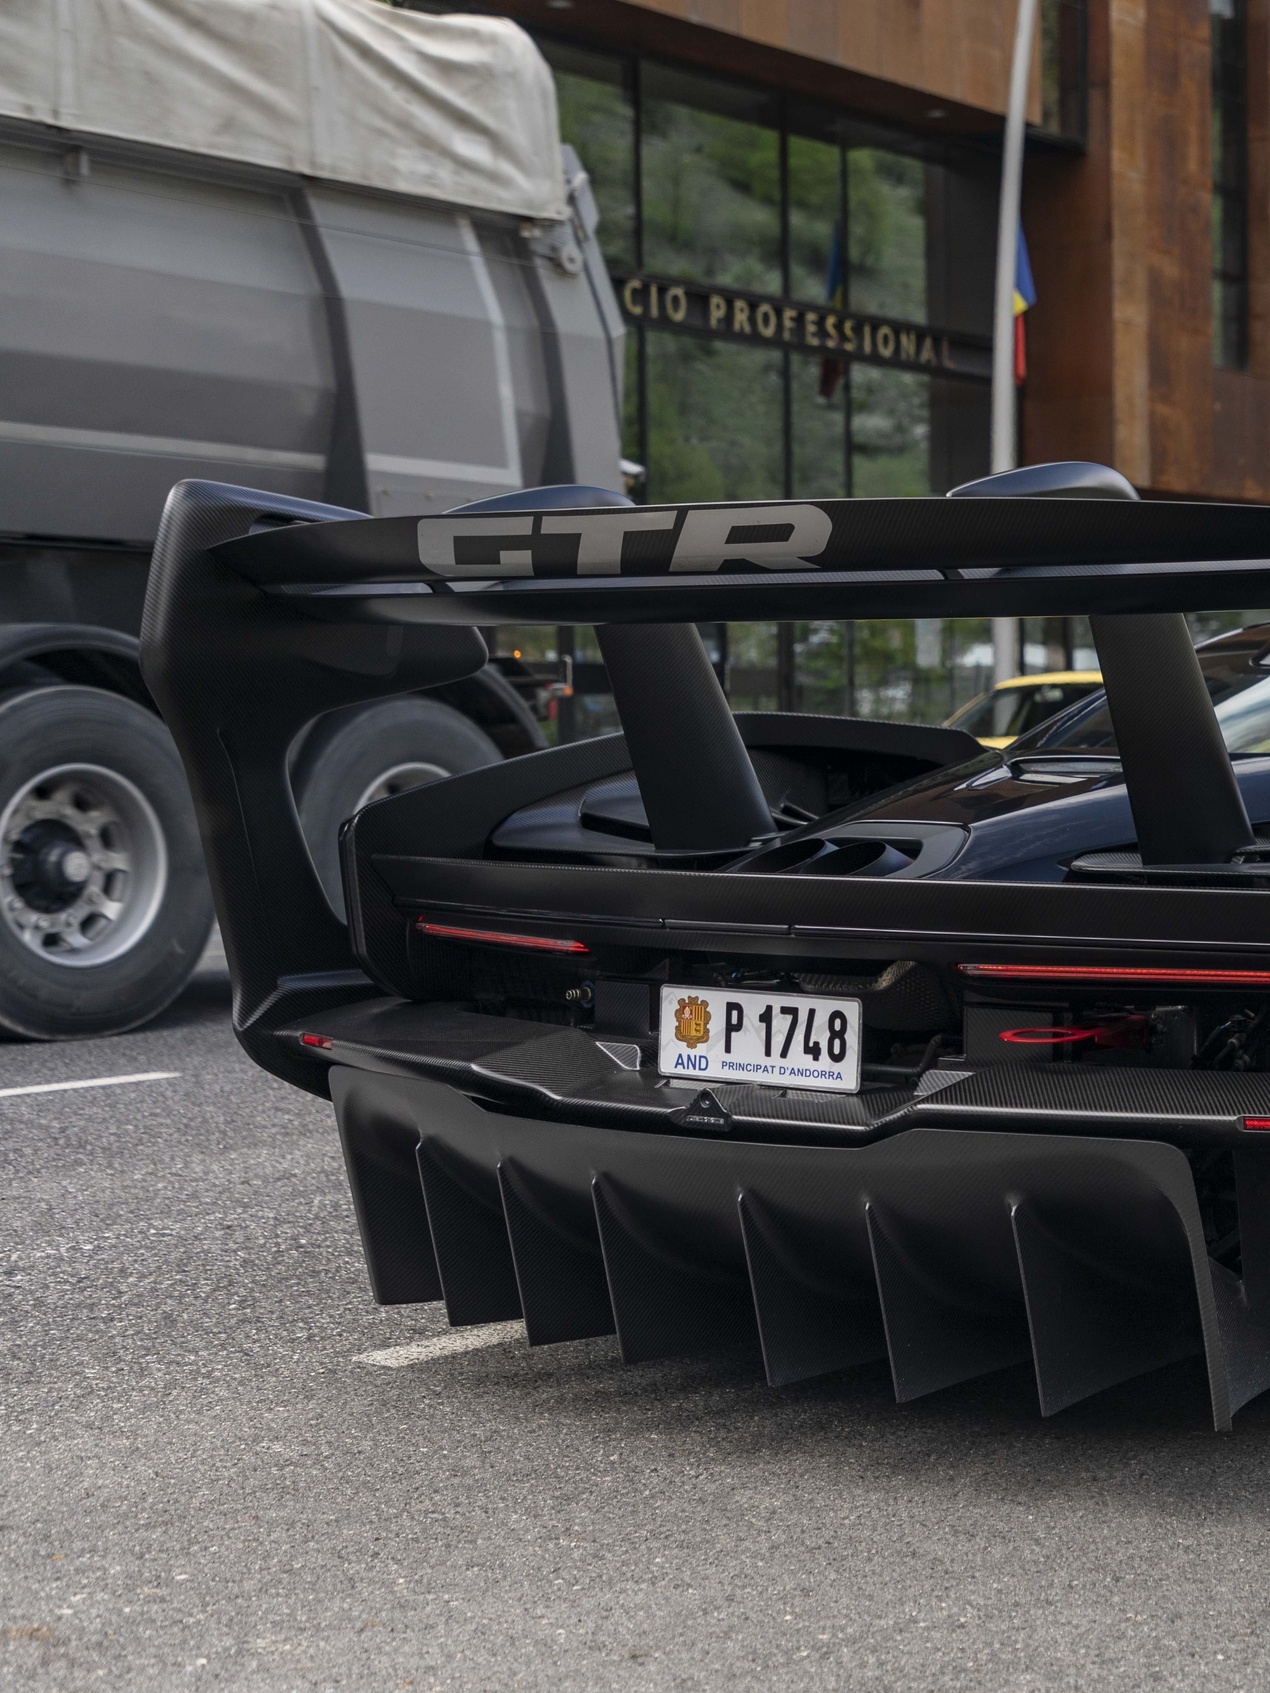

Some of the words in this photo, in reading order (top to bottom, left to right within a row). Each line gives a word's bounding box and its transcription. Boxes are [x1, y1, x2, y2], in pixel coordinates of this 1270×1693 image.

[709, 293, 956, 370] PROFESSIONAL
[417, 504, 833, 577] GTR
[674, 1053, 709, 1071] AND
[724, 1001, 744, 1054] P
[758, 1004, 848, 1063] 1748
[721, 1060, 776, 1076] PRINCIPAT
[778, 1066, 843, 1081] D'ANDORRA
